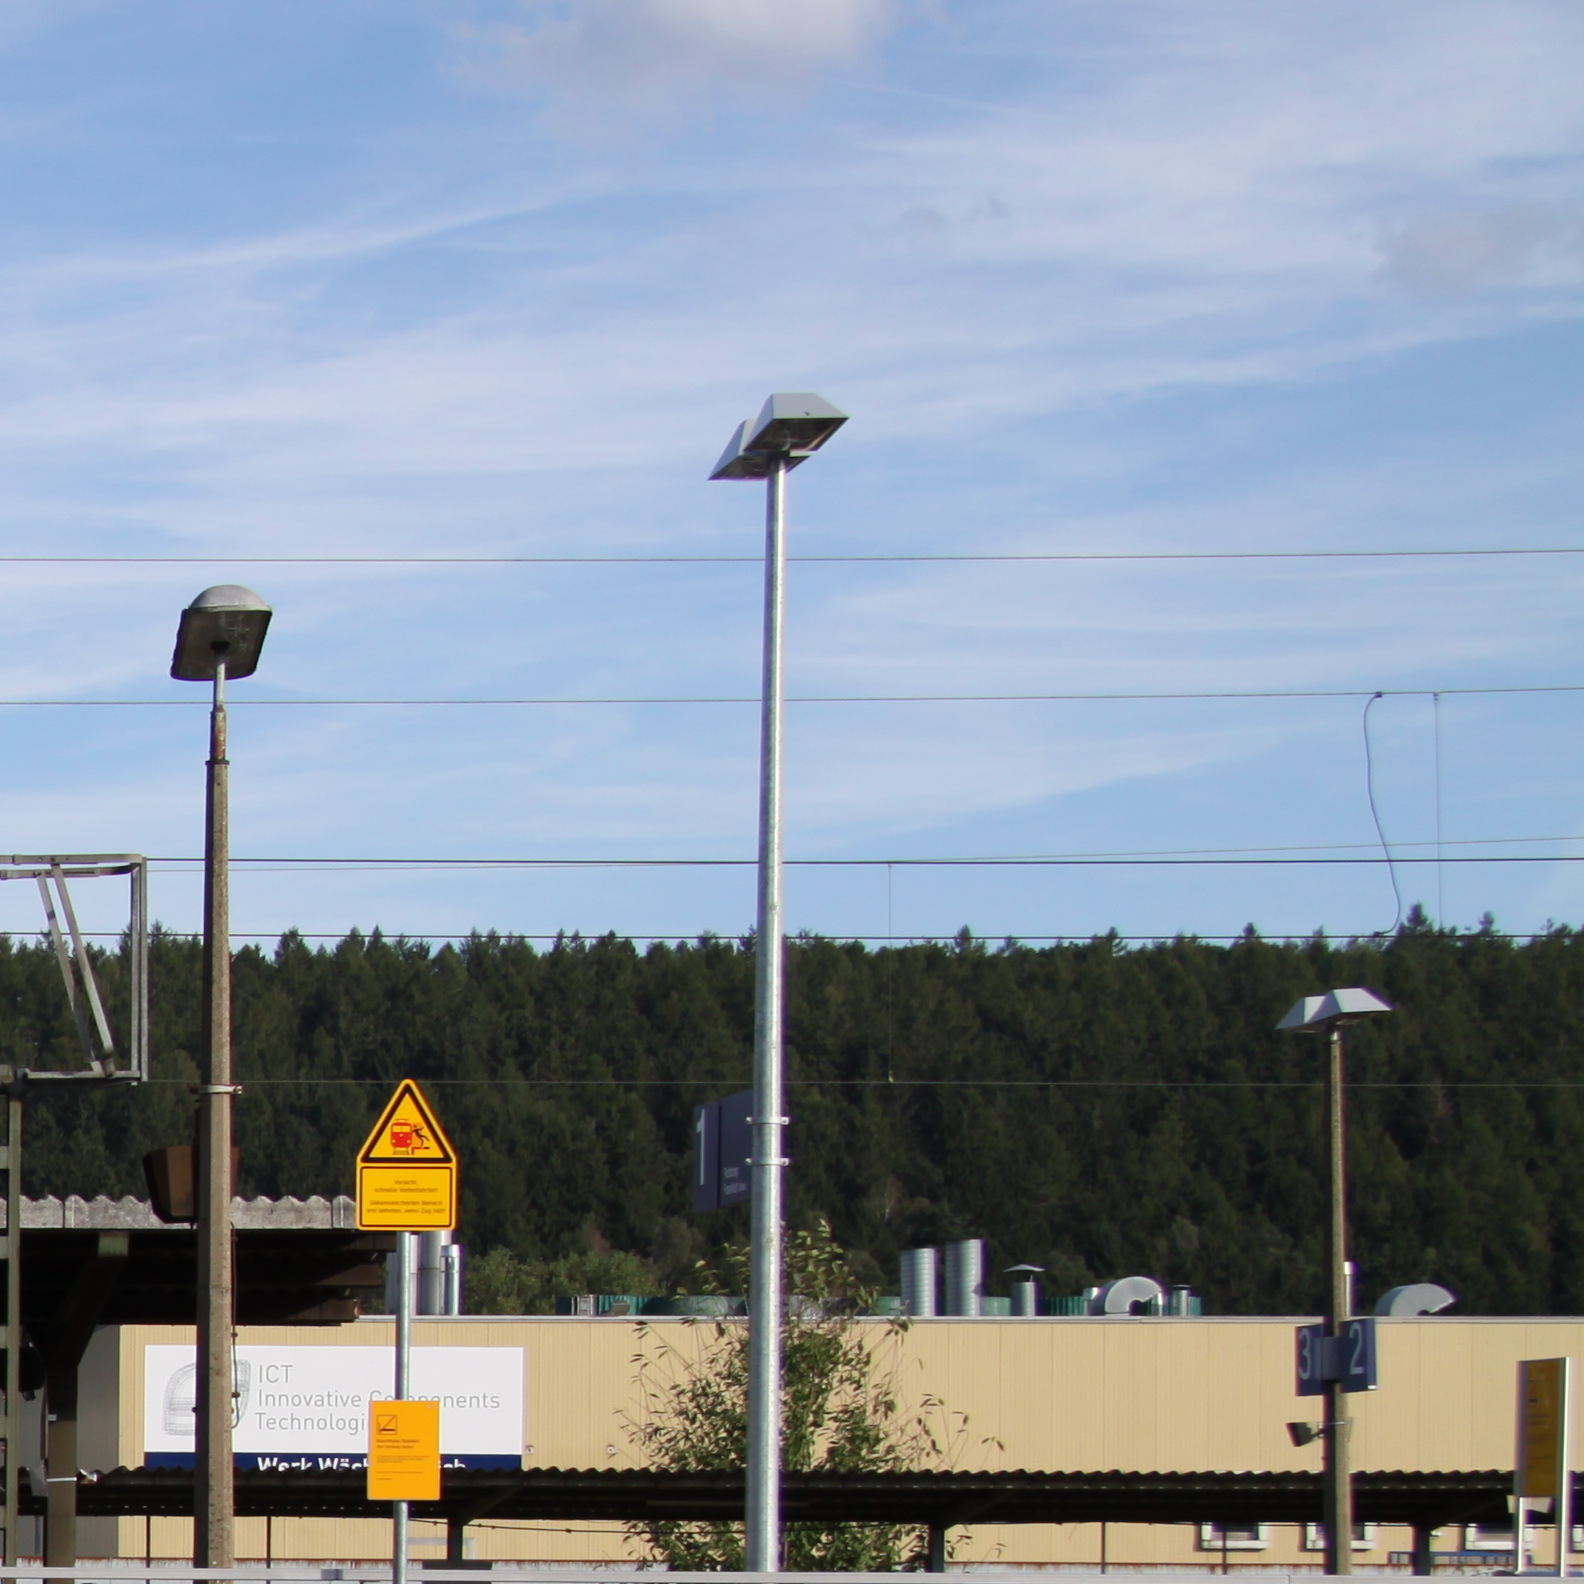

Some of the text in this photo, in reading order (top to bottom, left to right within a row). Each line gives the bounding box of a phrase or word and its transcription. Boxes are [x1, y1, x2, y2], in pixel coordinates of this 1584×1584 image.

[696, 1108, 706, 1186] 1
[1298, 1328, 1311, 1380] 3
[1349, 1321, 1365, 1375] 2
[258, 1364, 294, 1384] ICT
[257, 1389, 362, 1408] Innovative
[255, 1412, 369, 1436] Technologi
